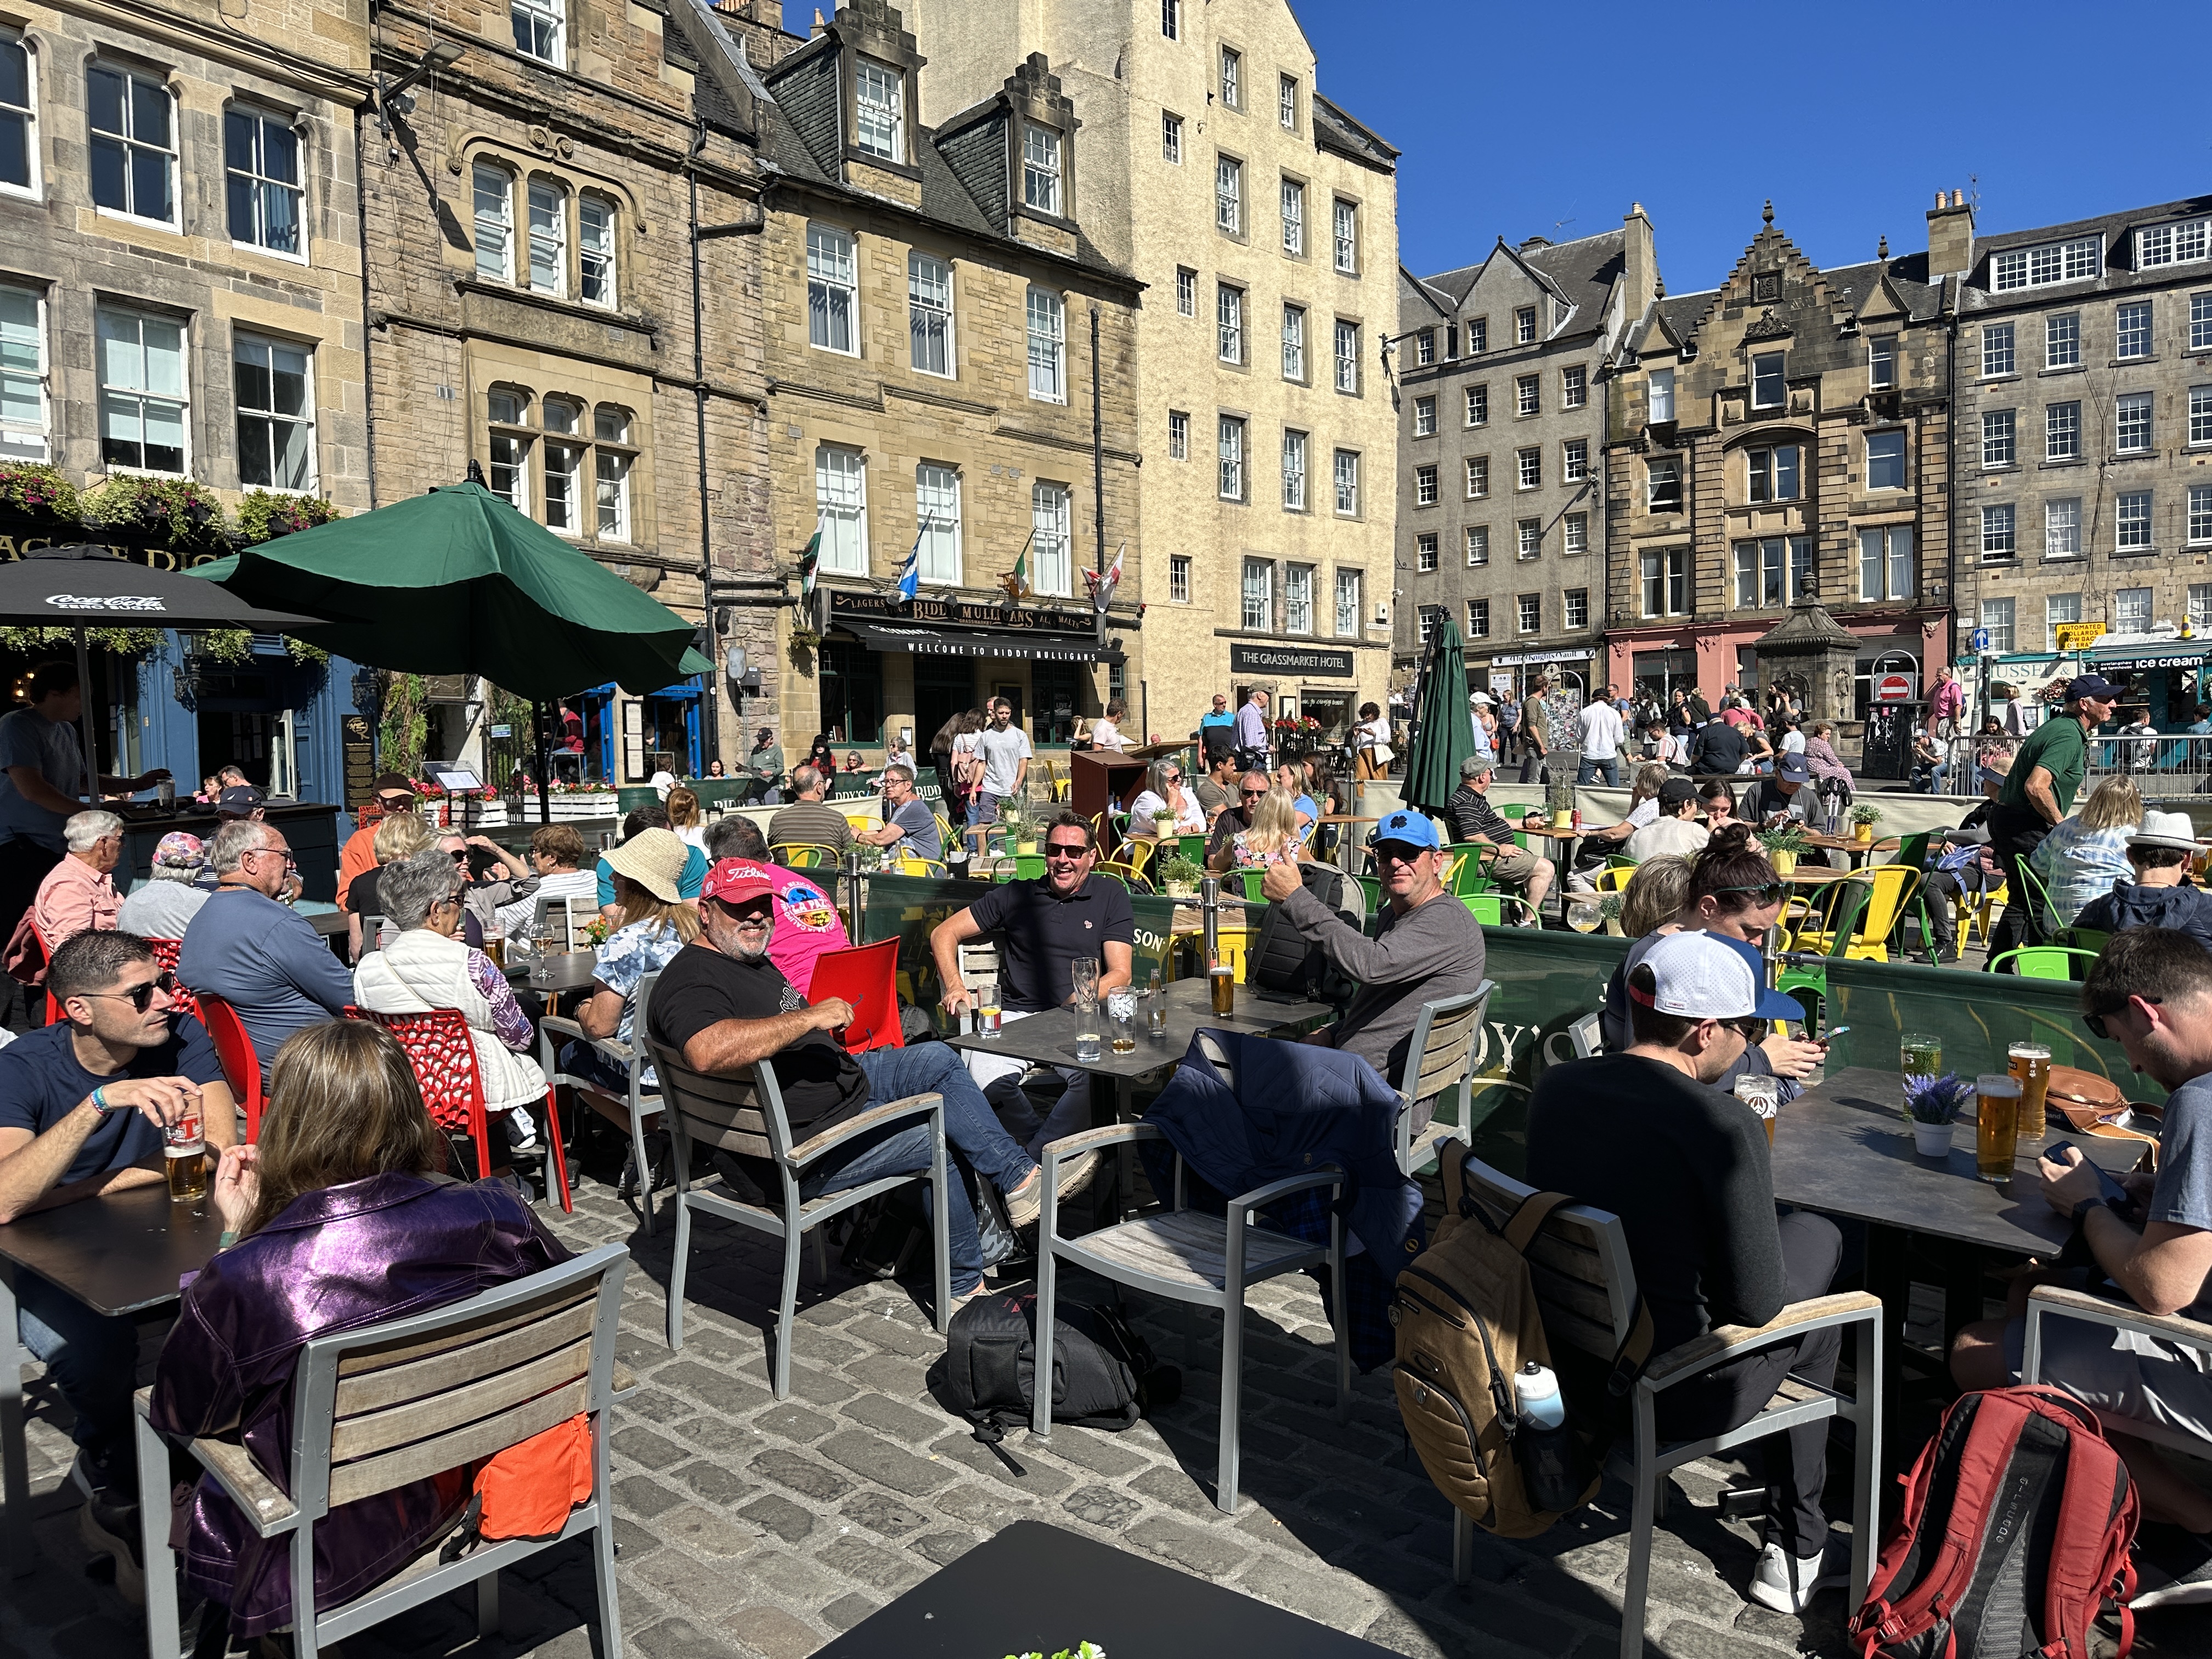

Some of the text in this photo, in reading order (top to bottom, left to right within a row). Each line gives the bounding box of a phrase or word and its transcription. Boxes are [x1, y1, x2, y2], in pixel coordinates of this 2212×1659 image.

[46, 594, 164, 607] Coca-Cola
[851, 599, 885, 608] LAGERS
[884, 606, 907, 614] STOUT
[913, 601, 1034, 628] BIDDY MULLIGANS
[1040, 615, 1056, 627] ALES
[1058, 615, 1080, 629] MALTS
[908, 642, 1096, 662] WELCOME TO BIDDY MULLIGANS
[1242, 652, 1345, 668] THE GRASSMARKET HOTEL
[2158, 657, 2203, 668] cream
[2060, 667, 2070, 675] &
[791, 899, 828, 914] LA PAZ
[1132, 928, 1164, 952] SON
